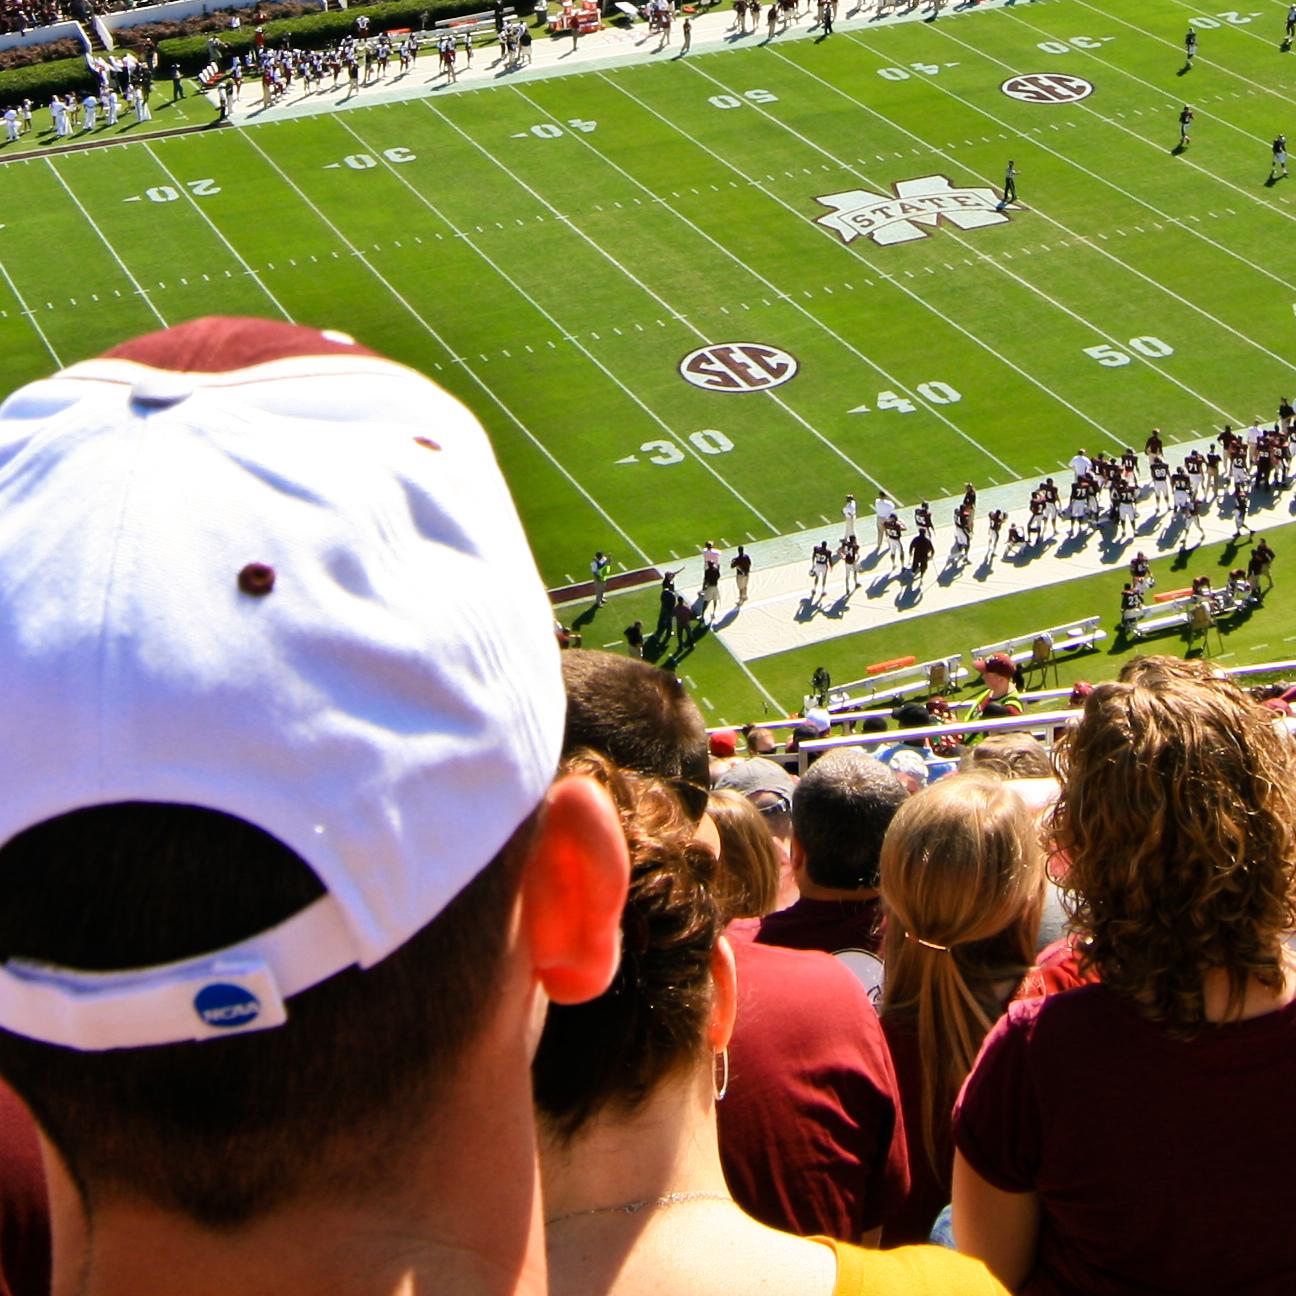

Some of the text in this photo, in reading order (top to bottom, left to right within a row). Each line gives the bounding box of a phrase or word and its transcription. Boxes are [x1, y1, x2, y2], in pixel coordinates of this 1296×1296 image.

[1188, 10, 1253, 30] 20
[1037, 35, 1104, 55] 30
[876, 61, 941, 81] 40
[708, 89, 779, 110] 50
[1004, 74, 1090, 103] SEC
[530, 118, 598, 139] 40
[343, 146, 417, 170] 30
[145, 177, 222, 203] 20
[850, 194, 985, 229] STATE
[1081, 335, 1175, 368] 50
[685, 345, 790, 389] SEC
[876, 381, 962, 414] 40
[639, 429, 735, 466] 30
